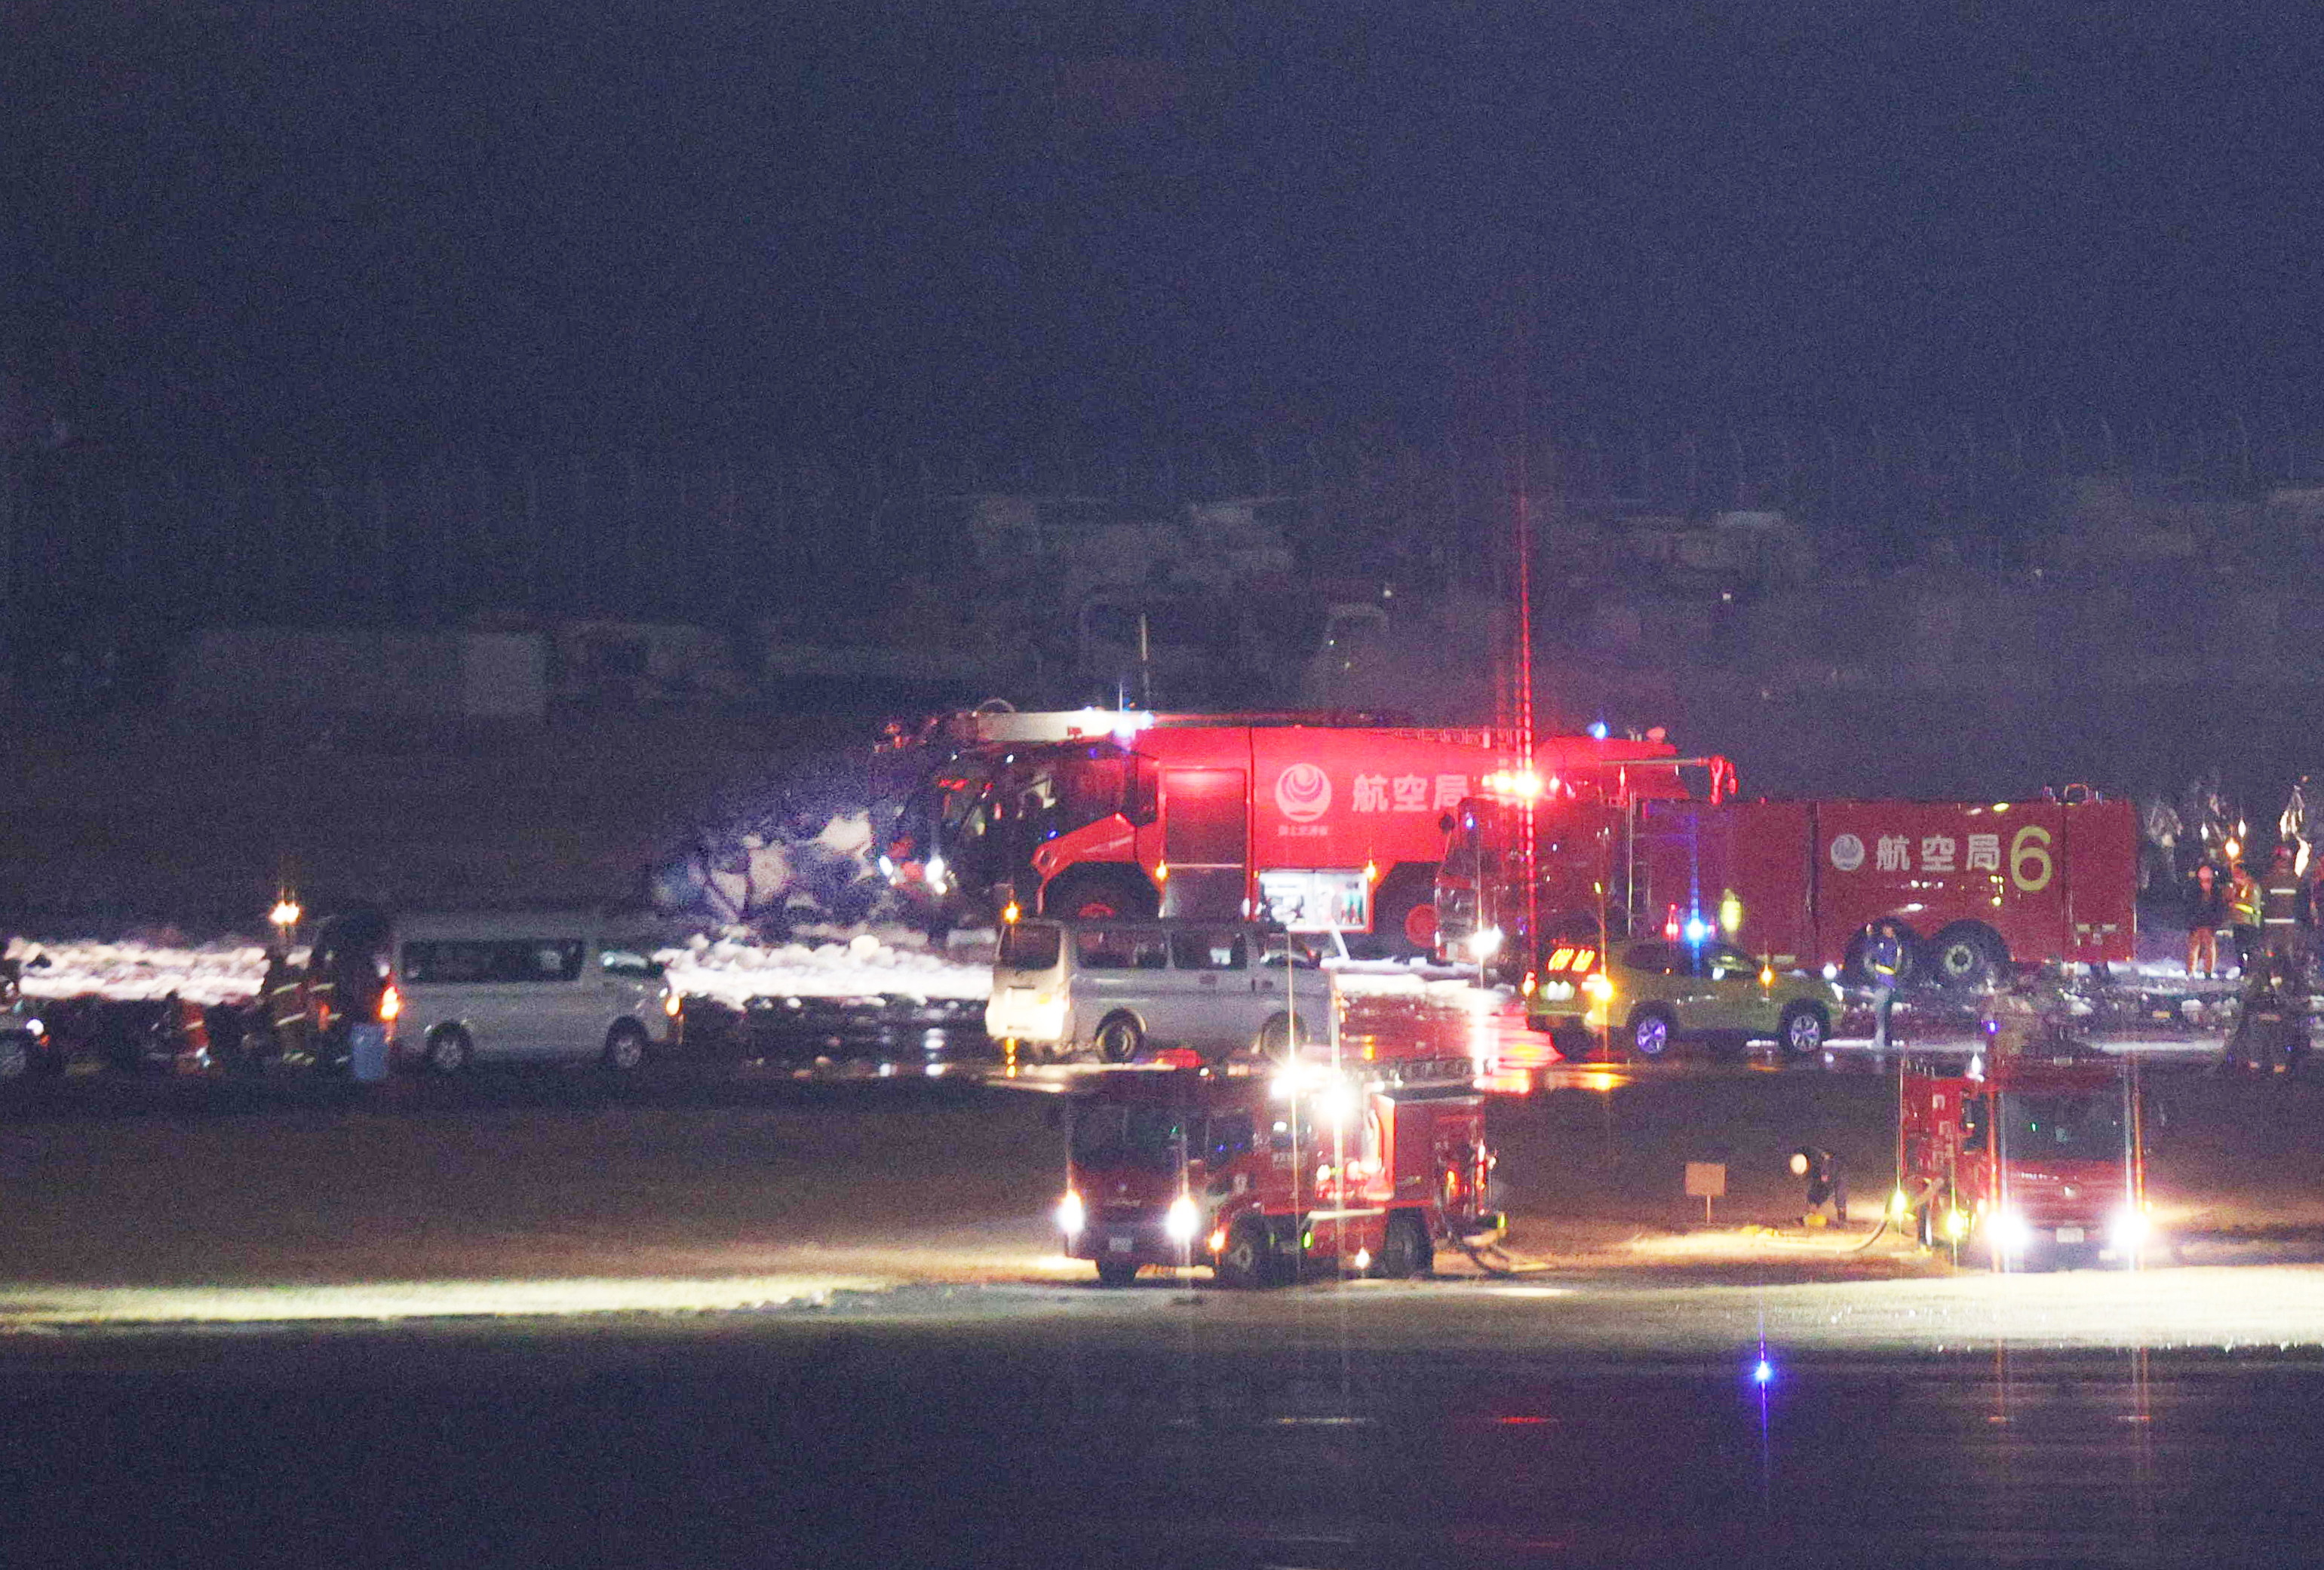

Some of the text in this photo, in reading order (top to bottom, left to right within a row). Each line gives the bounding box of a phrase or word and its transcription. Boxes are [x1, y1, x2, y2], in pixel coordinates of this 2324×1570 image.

[1352, 774, 1469, 812] 航空局
[1876, 825, 2052, 891] 航空局 6
